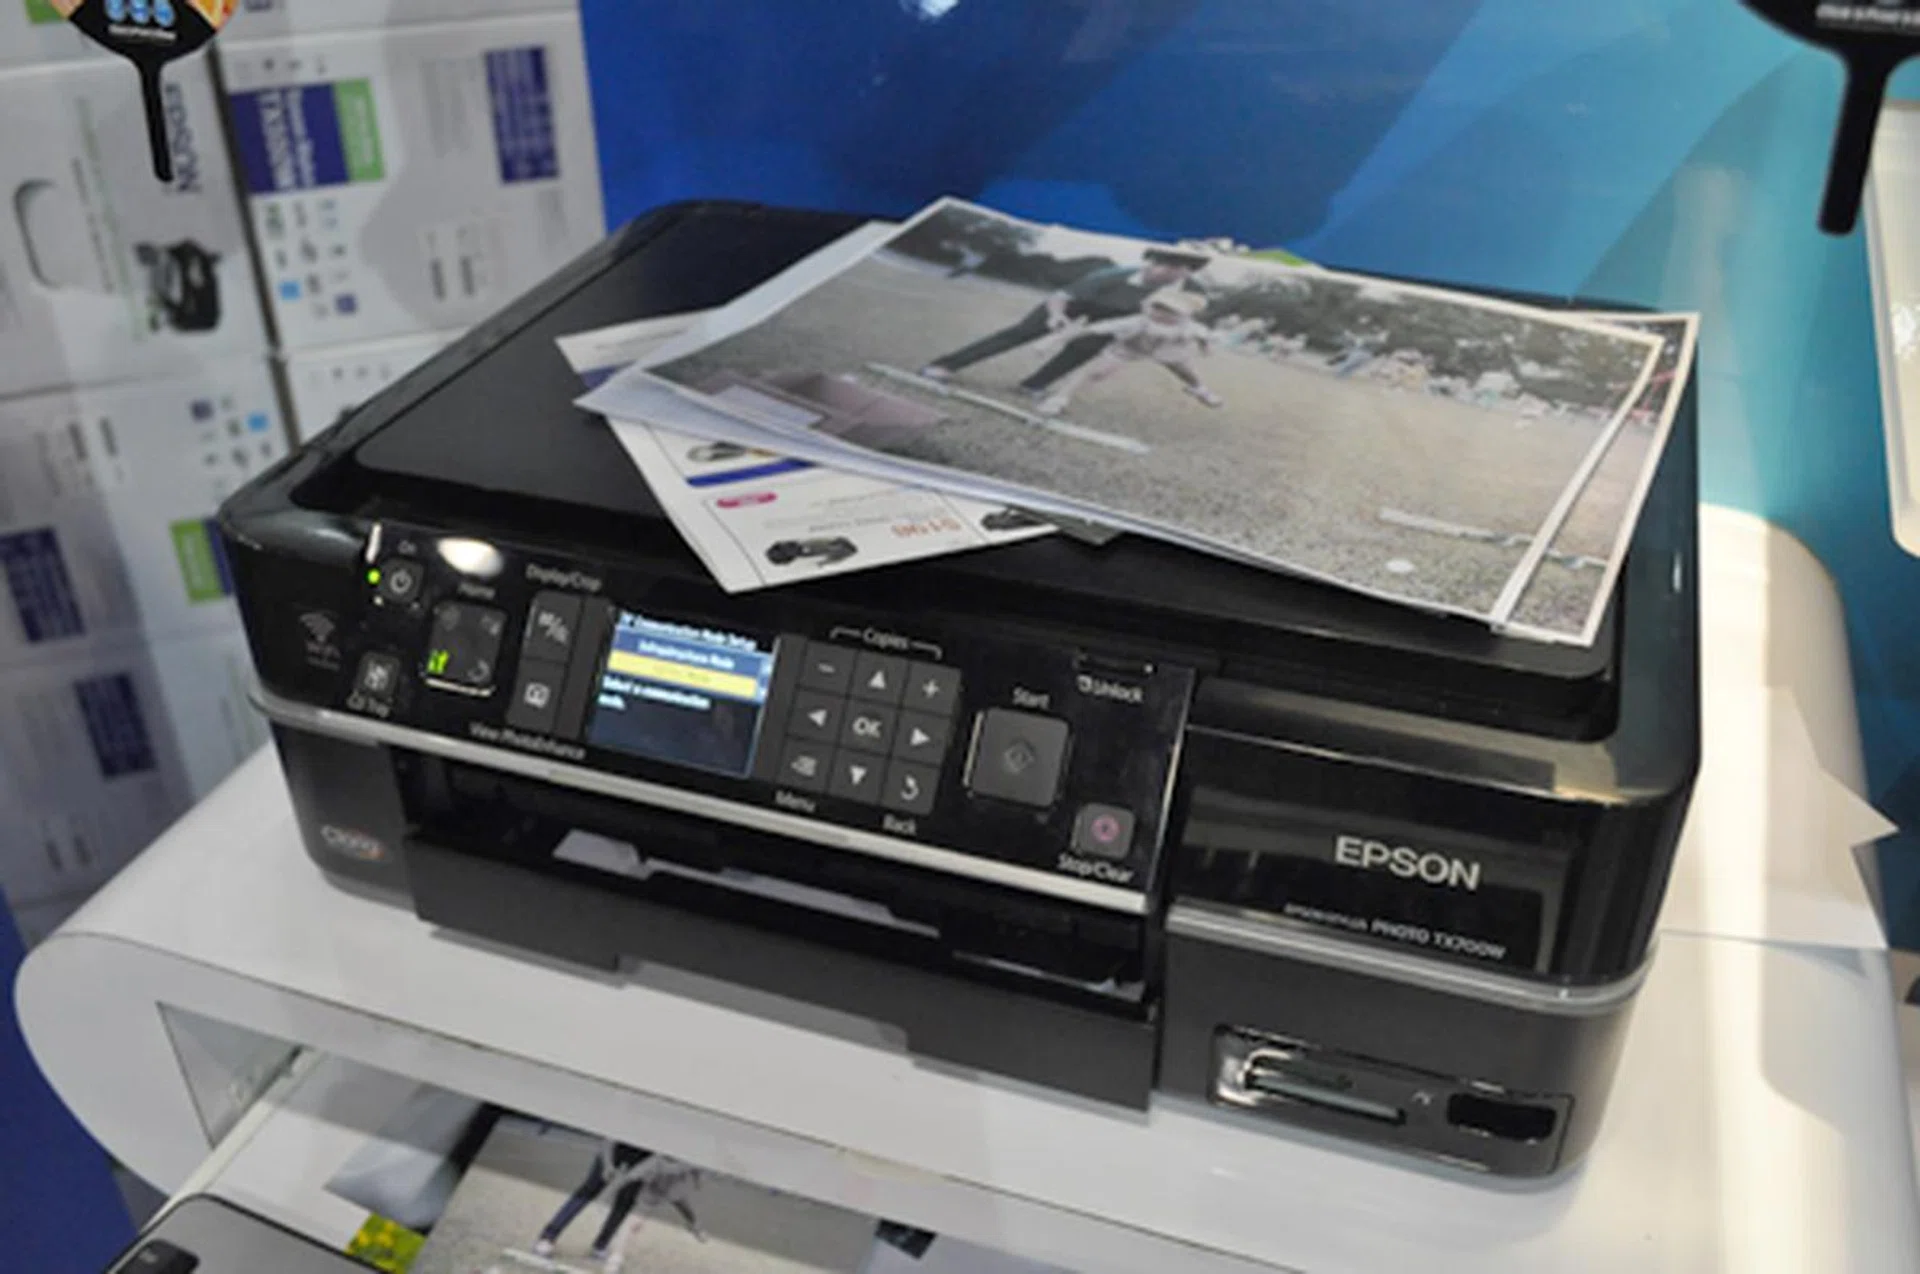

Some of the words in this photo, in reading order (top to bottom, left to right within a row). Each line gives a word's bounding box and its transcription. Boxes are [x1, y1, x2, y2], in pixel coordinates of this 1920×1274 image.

[852, 716, 883, 738] OK
[1333, 834, 1482, 892] EPSON
[1370, 918, 1431, 946] PHOTO
